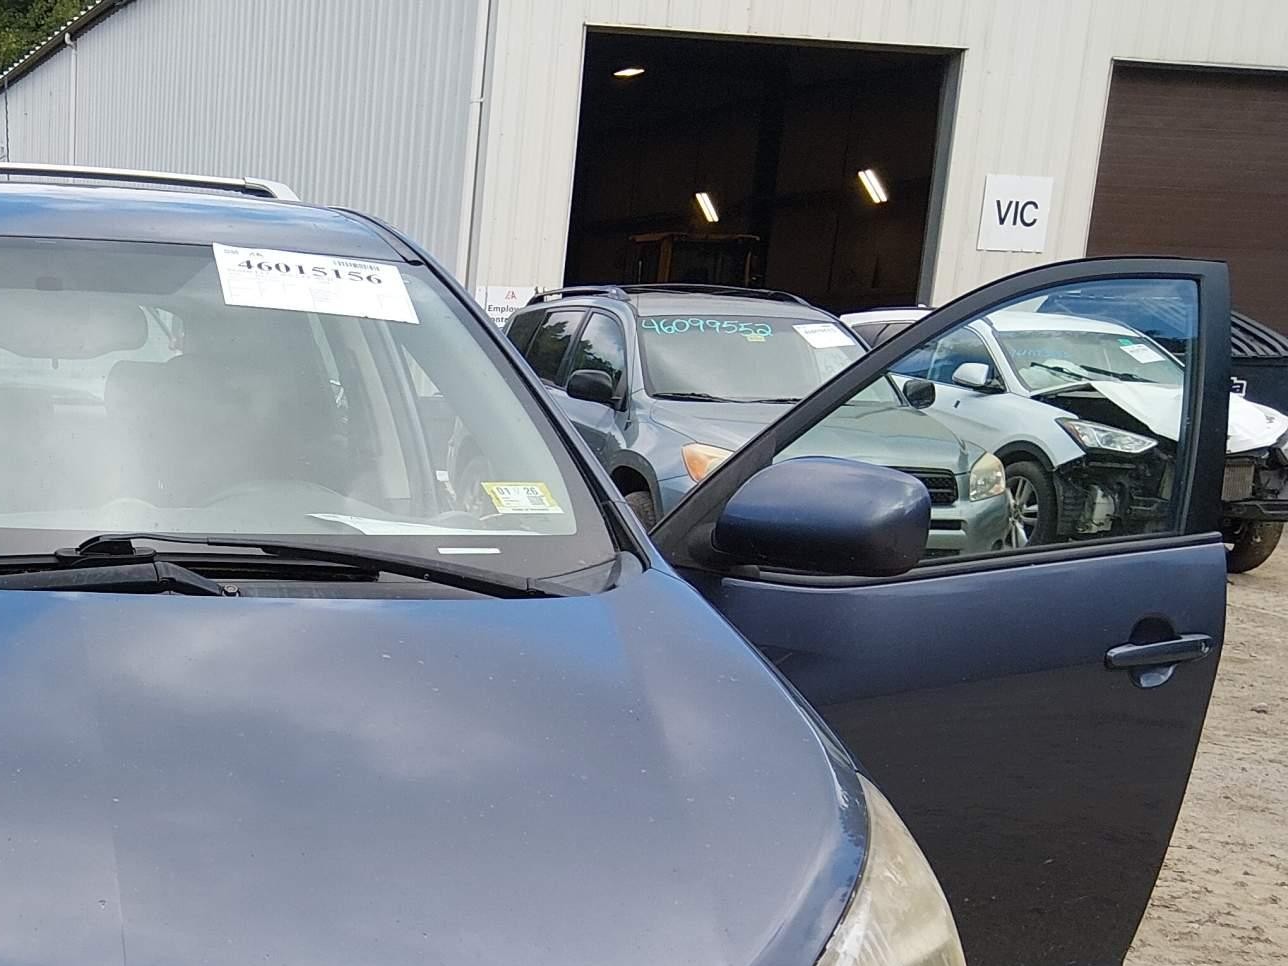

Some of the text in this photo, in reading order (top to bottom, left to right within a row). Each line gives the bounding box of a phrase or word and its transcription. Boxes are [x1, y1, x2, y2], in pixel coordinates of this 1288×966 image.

[996, 200, 1039, 227] VIC
[238, 259, 382, 284] 46015156
[641, 318, 773, 337] 46099552
